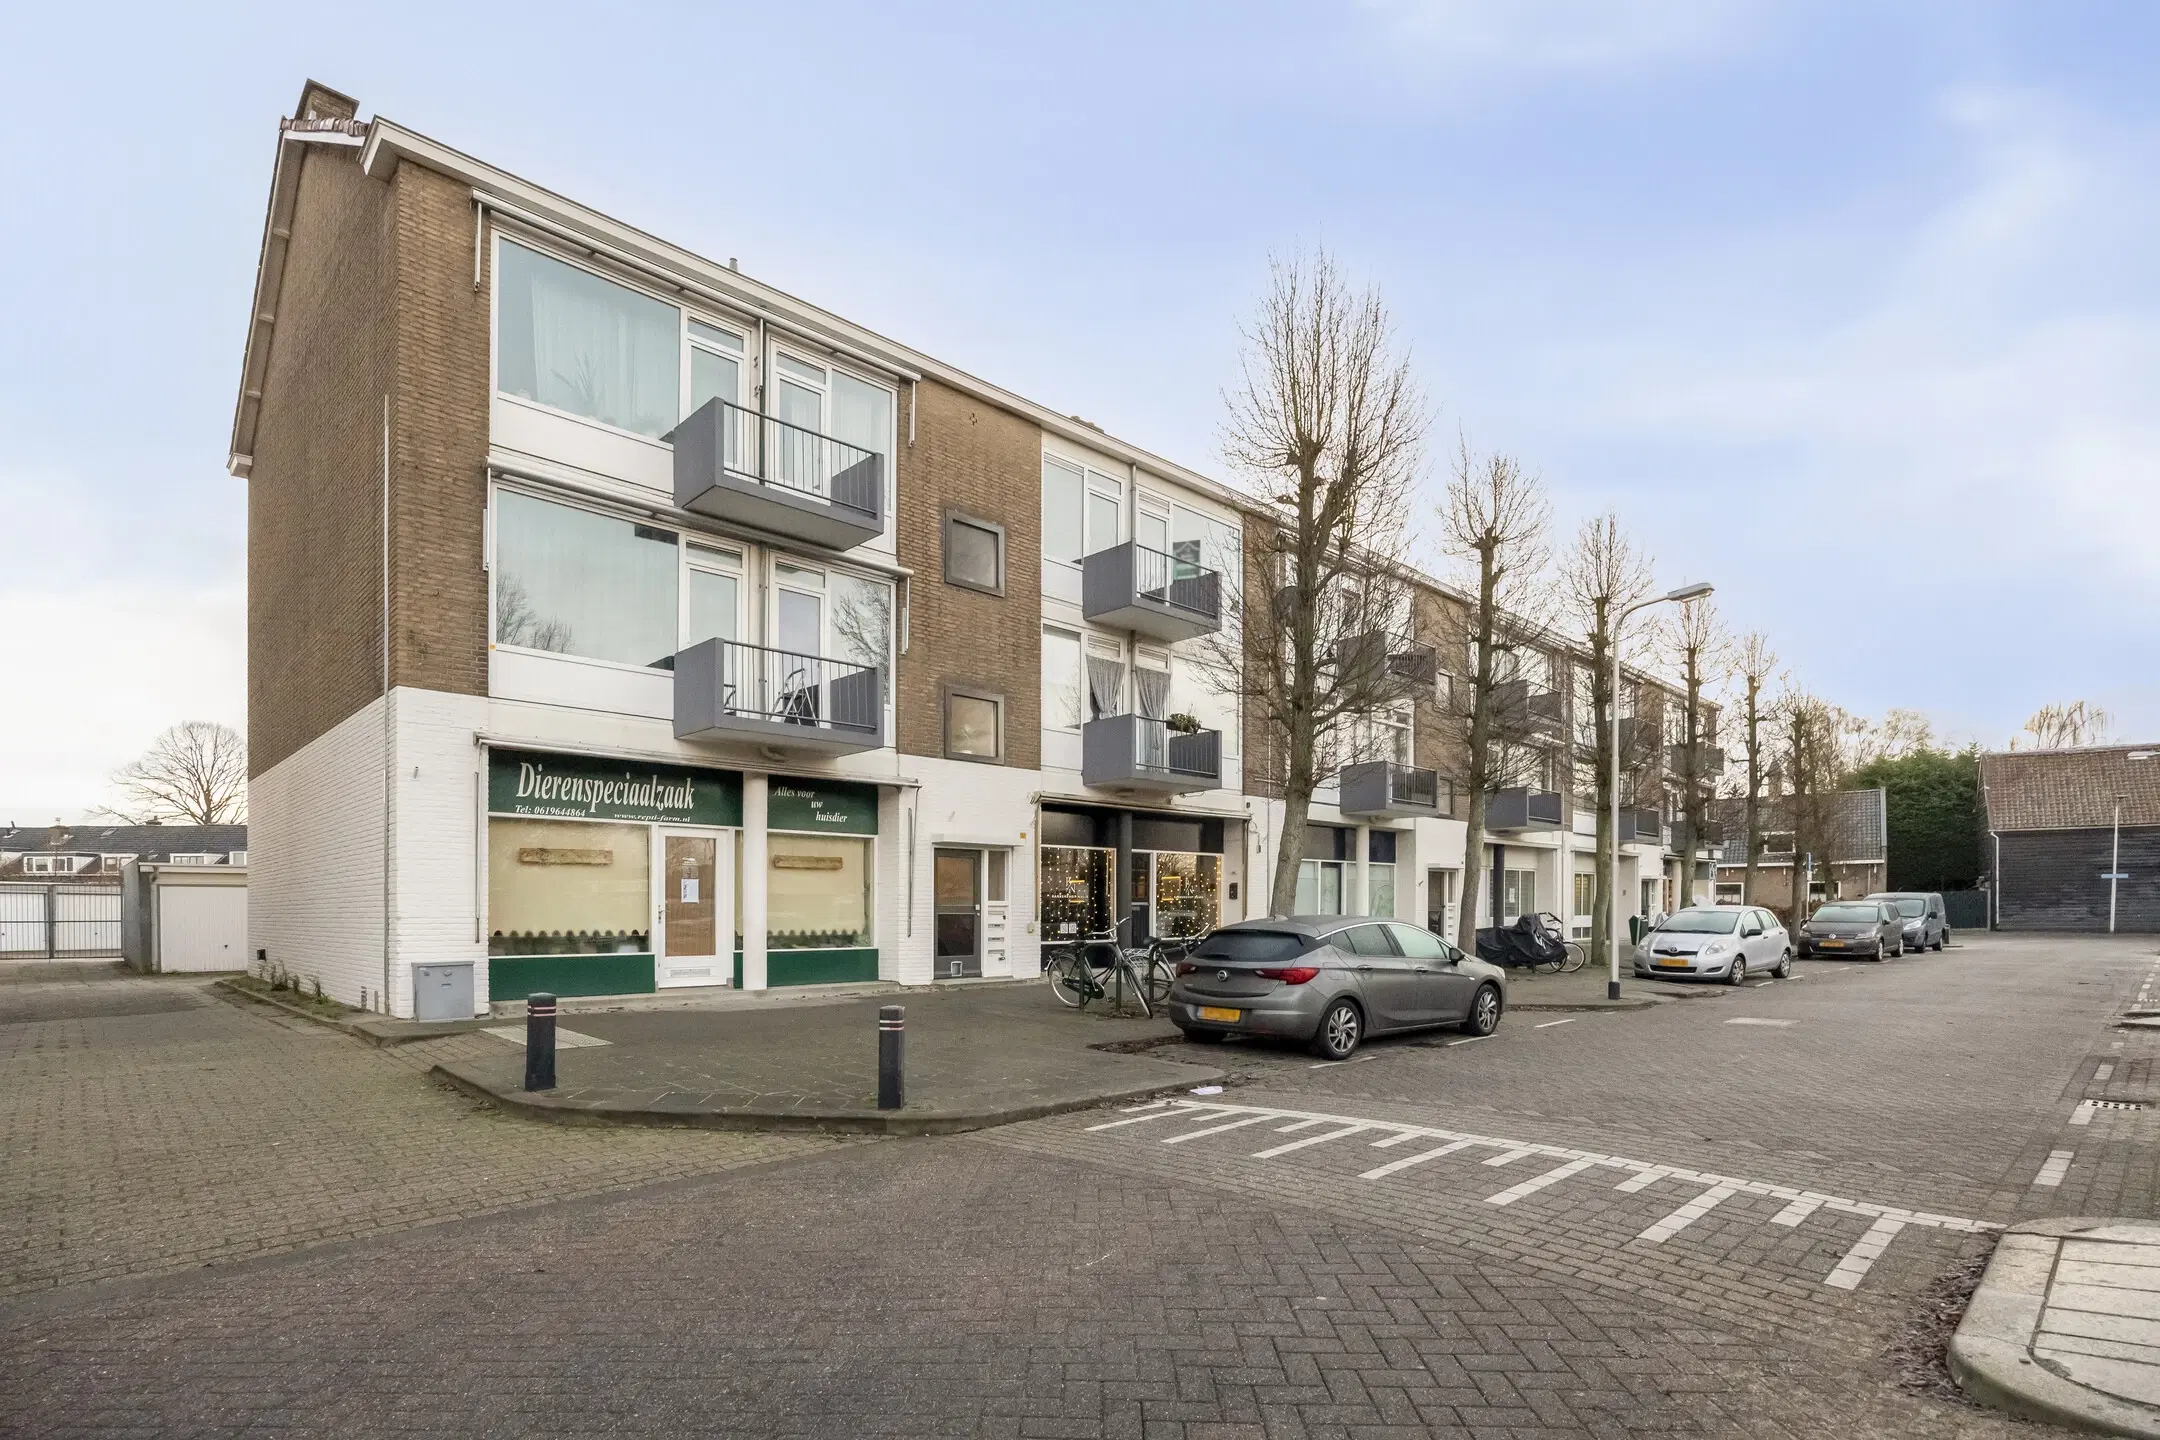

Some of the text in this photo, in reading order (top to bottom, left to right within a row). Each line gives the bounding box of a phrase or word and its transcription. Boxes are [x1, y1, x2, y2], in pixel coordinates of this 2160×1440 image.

[515, 762, 695, 812] Dierenspeciaalzaak
[774, 786, 815, 798] Alles voor
[811, 800, 823, 809] uw
[515, 805, 586, 817] Tel: 0619644864
[815, 811, 848, 822] huisdier
[614, 813, 691, 823] www.repti-farm.nl
